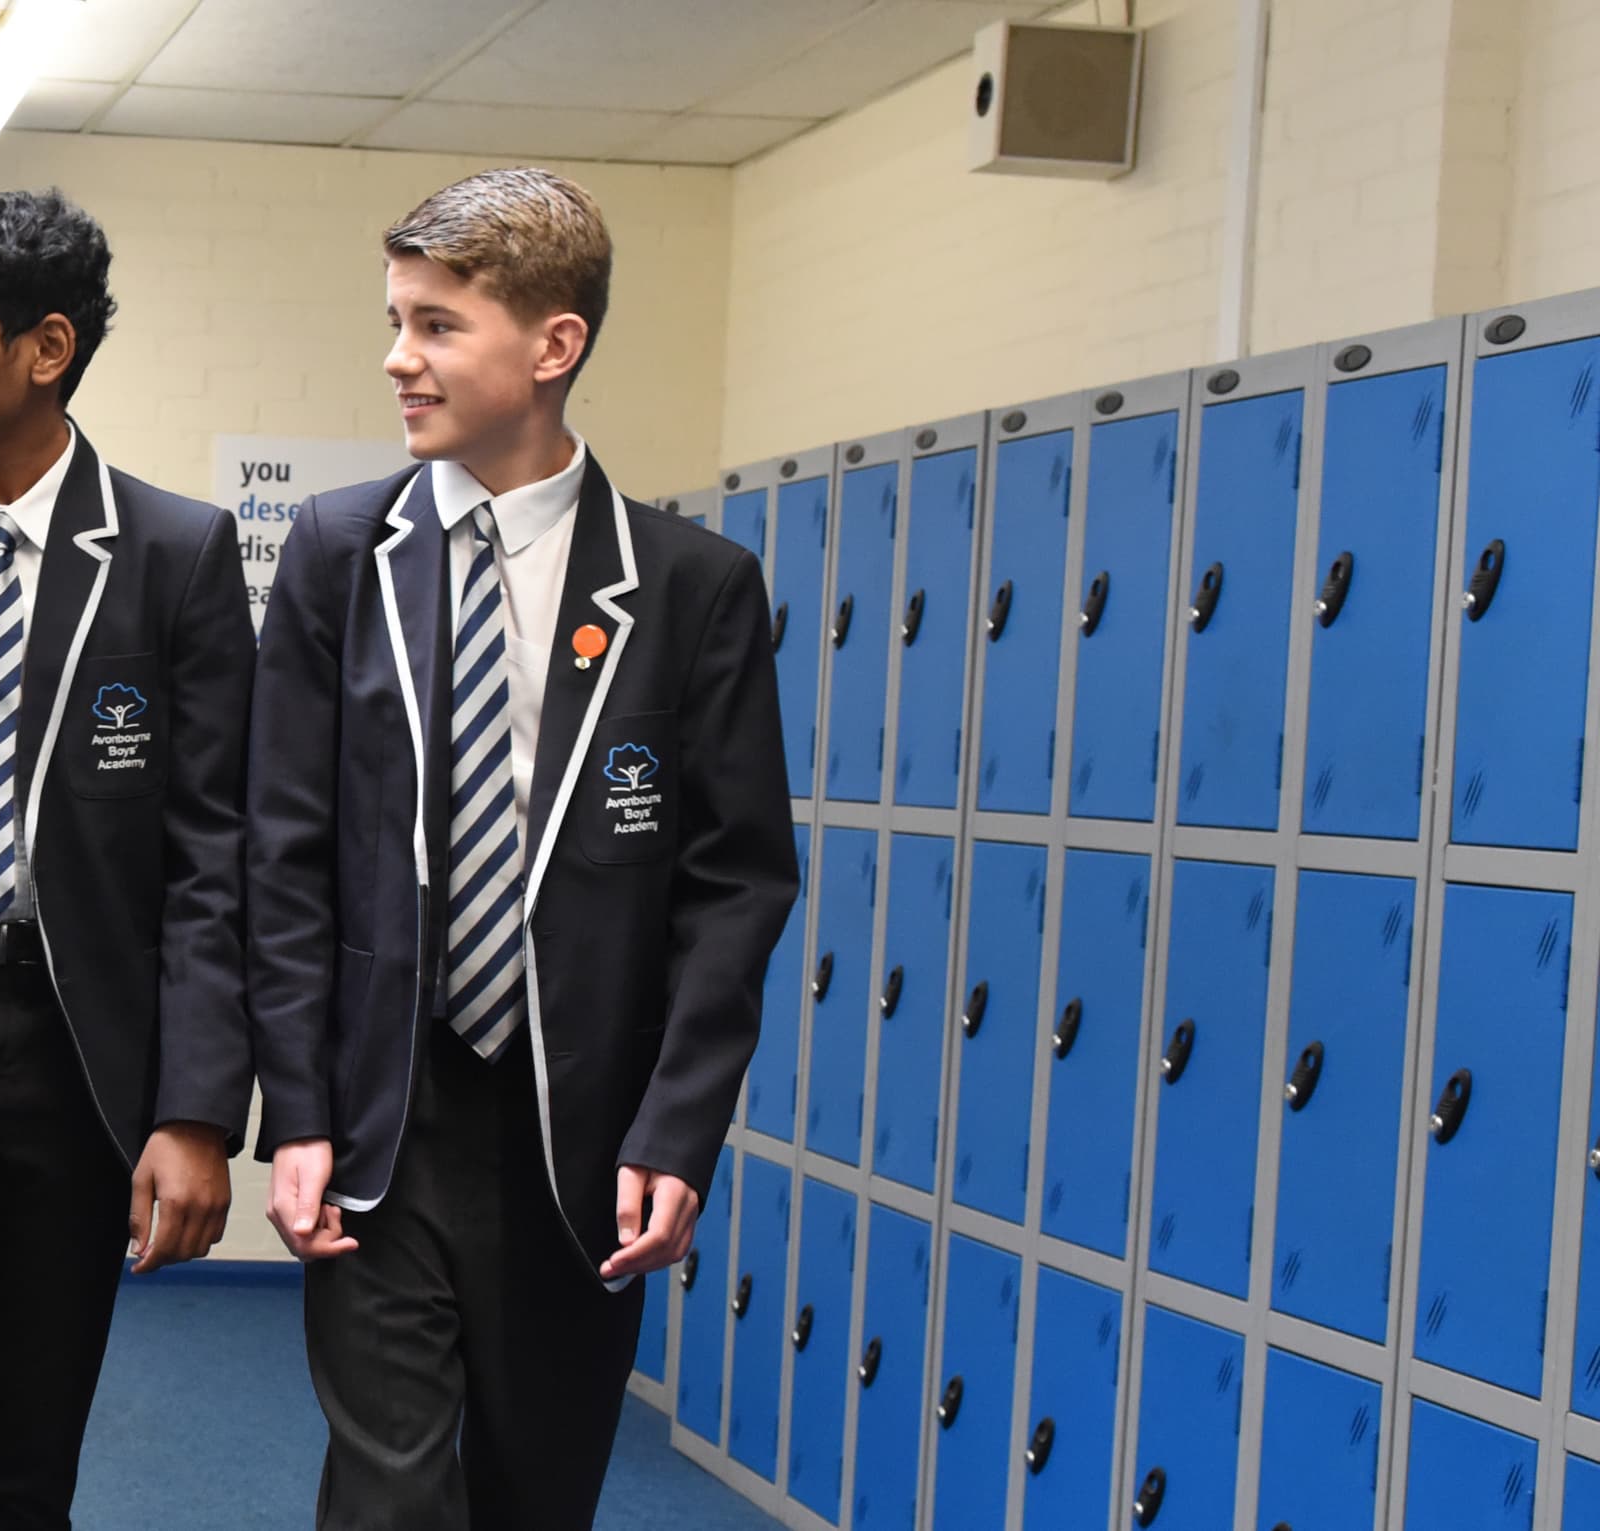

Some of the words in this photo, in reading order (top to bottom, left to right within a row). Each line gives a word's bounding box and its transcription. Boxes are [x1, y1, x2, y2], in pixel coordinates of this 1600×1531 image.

[240, 460, 291, 488] you
[240, 534, 285, 562] dis
[91, 733, 151, 746] Avonbourne
[97, 758, 147, 770] Academy
[605, 793, 662, 809] Avonbourne
[614, 820, 658, 834] Academy
